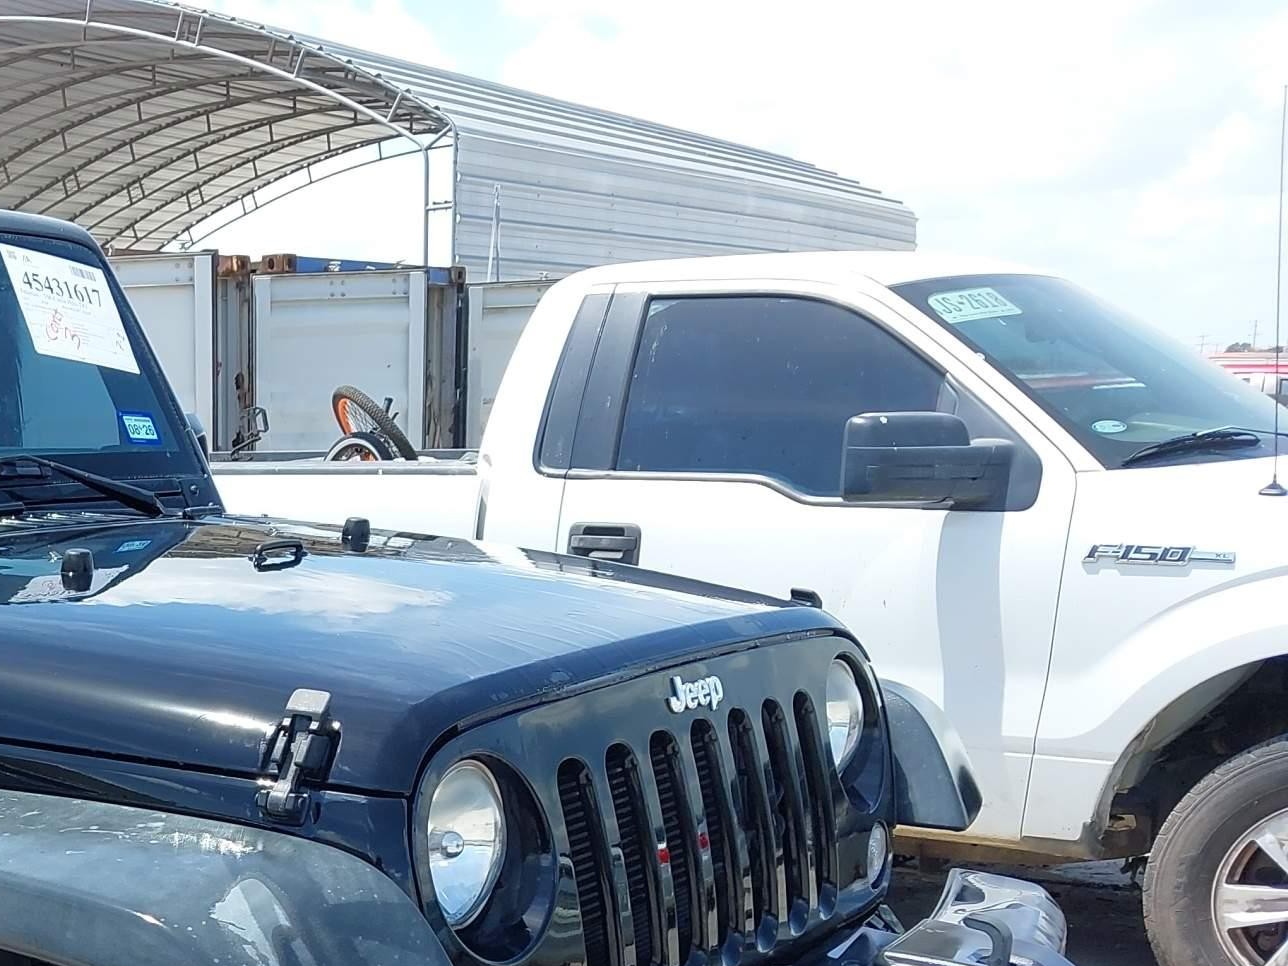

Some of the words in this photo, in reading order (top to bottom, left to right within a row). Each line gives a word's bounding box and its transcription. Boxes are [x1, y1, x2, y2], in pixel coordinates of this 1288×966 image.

[22, 271, 102, 308] 45431617
[1082, 544, 1194, 565] F-150
[1214, 552, 1230, 560] XL
[666, 675, 724, 713] Jeep
